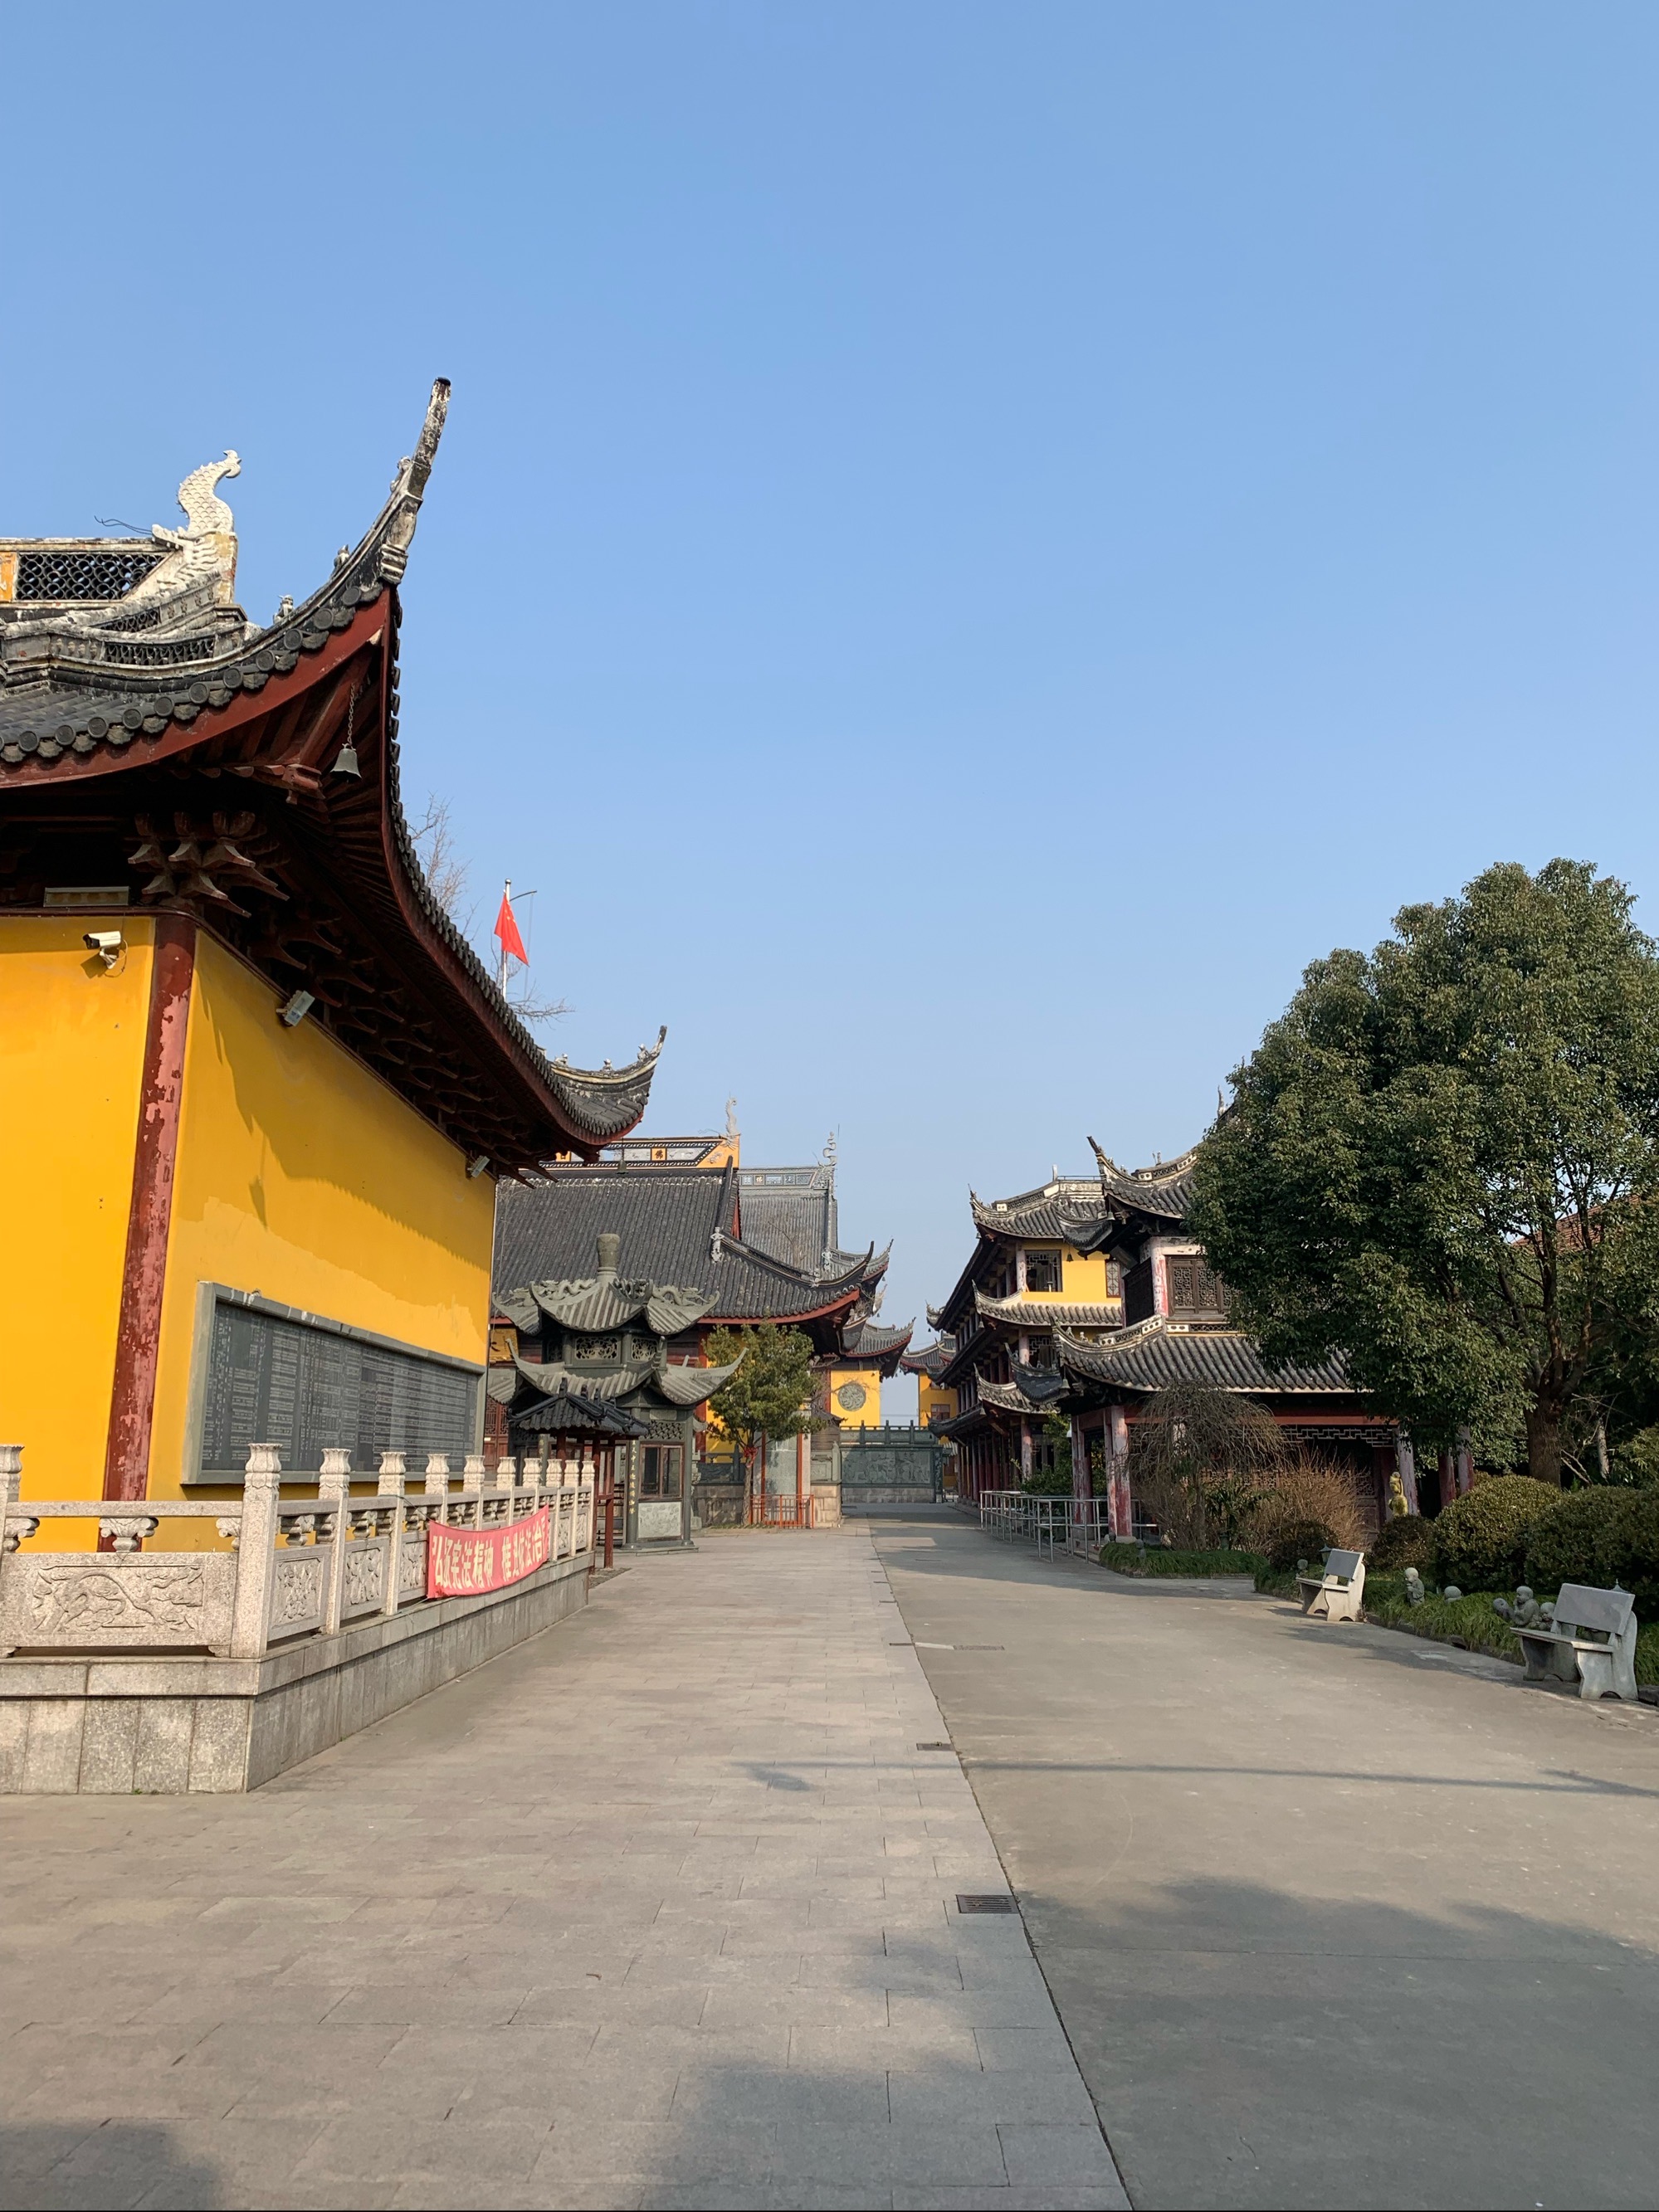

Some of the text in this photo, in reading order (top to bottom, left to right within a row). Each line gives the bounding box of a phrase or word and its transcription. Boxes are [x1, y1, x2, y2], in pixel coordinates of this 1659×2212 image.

[431, 1535, 494, 1590] 弘扬宪法精神
